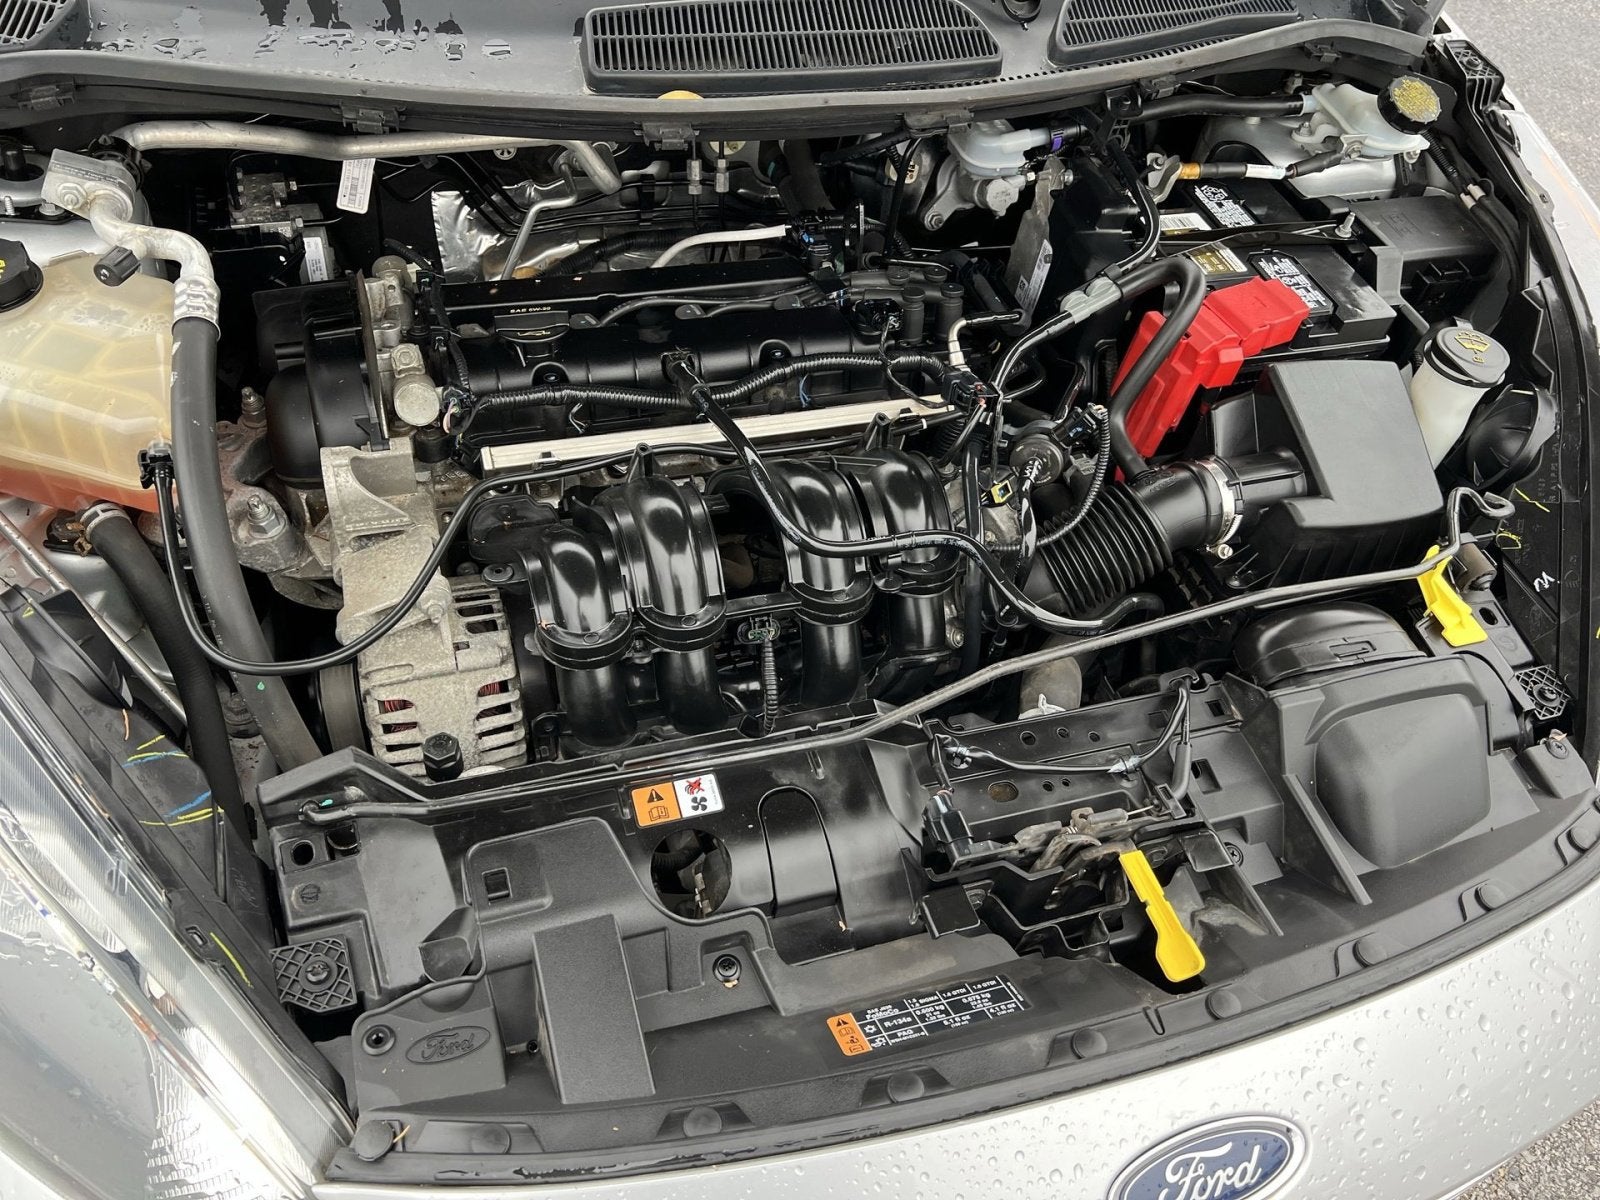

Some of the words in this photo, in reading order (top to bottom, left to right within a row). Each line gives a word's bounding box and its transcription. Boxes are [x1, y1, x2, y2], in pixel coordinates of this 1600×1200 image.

[918, 995, 939, 1003] SIGMA
[883, 1016, 912, 1028] R-134a
[896, 1029, 914, 1037] PAG
[421, 1032, 475, 1060] Ford
[1157, 1141, 1262, 1200] Ford
